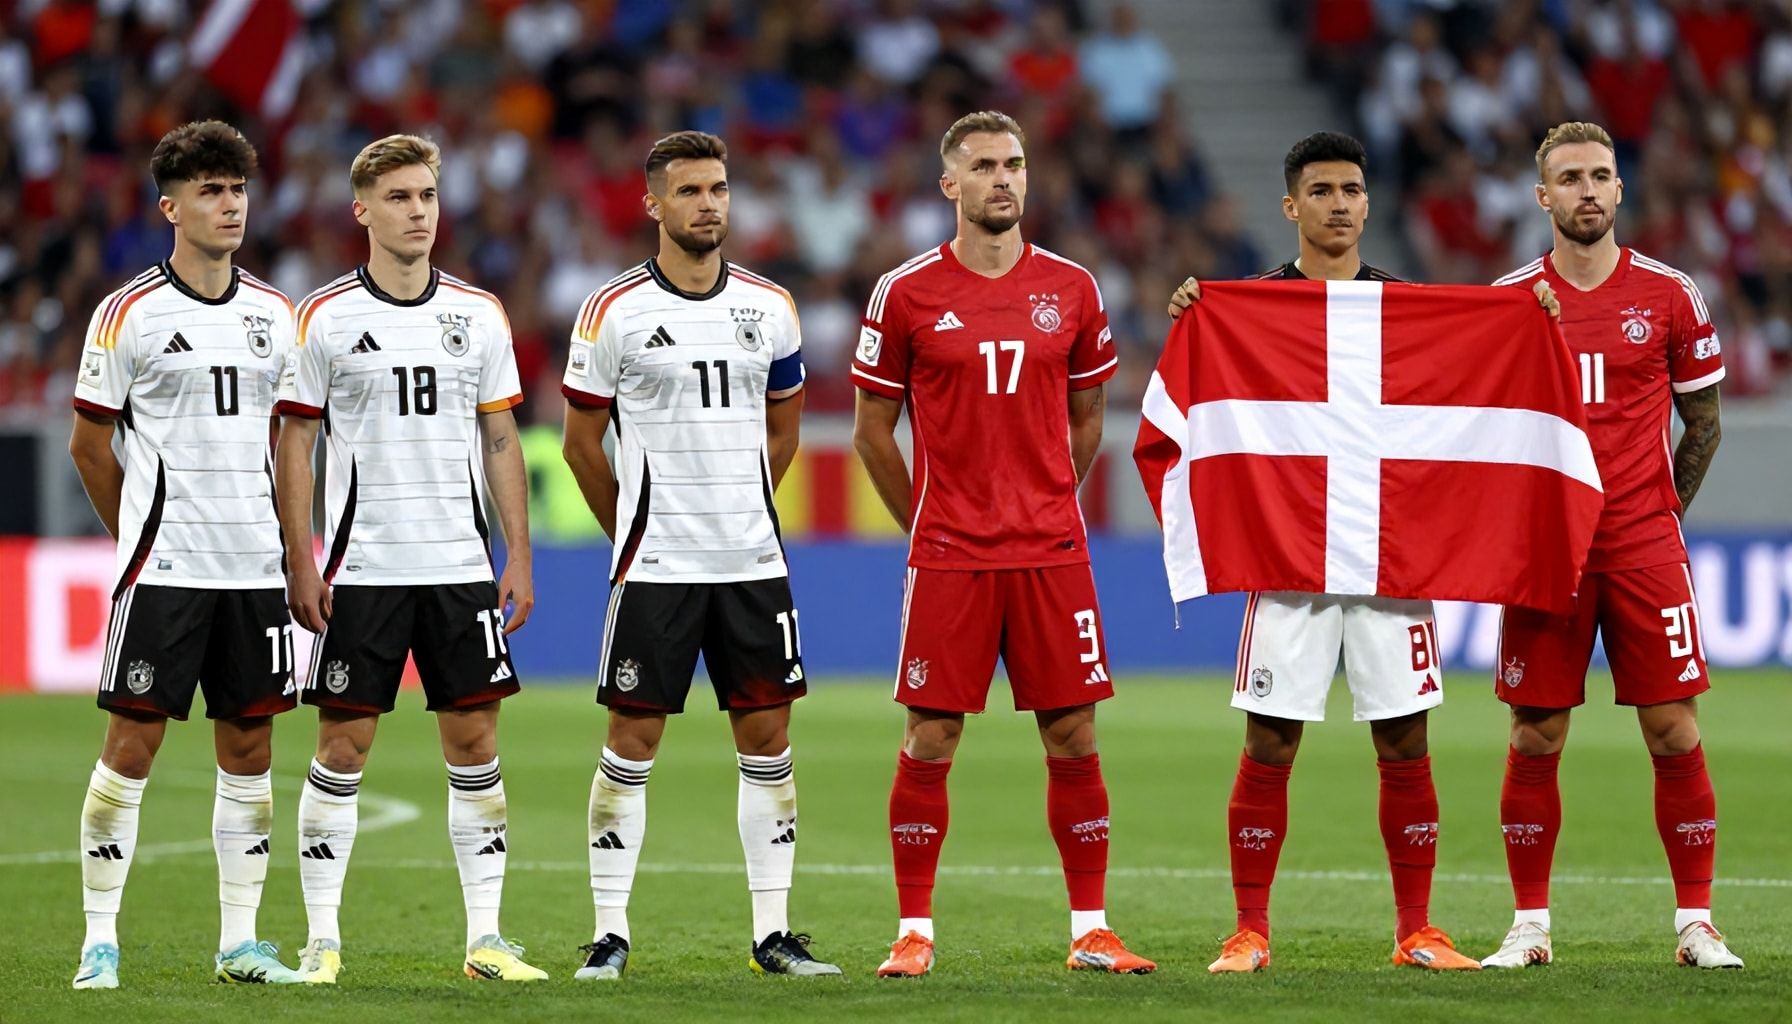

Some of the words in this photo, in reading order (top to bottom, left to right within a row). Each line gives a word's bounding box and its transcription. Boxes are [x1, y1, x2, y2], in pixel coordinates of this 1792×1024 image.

[391, 365, 438, 416] 18
[691, 360, 731, 408] 11
[979, 340, 1025, 395] 17
